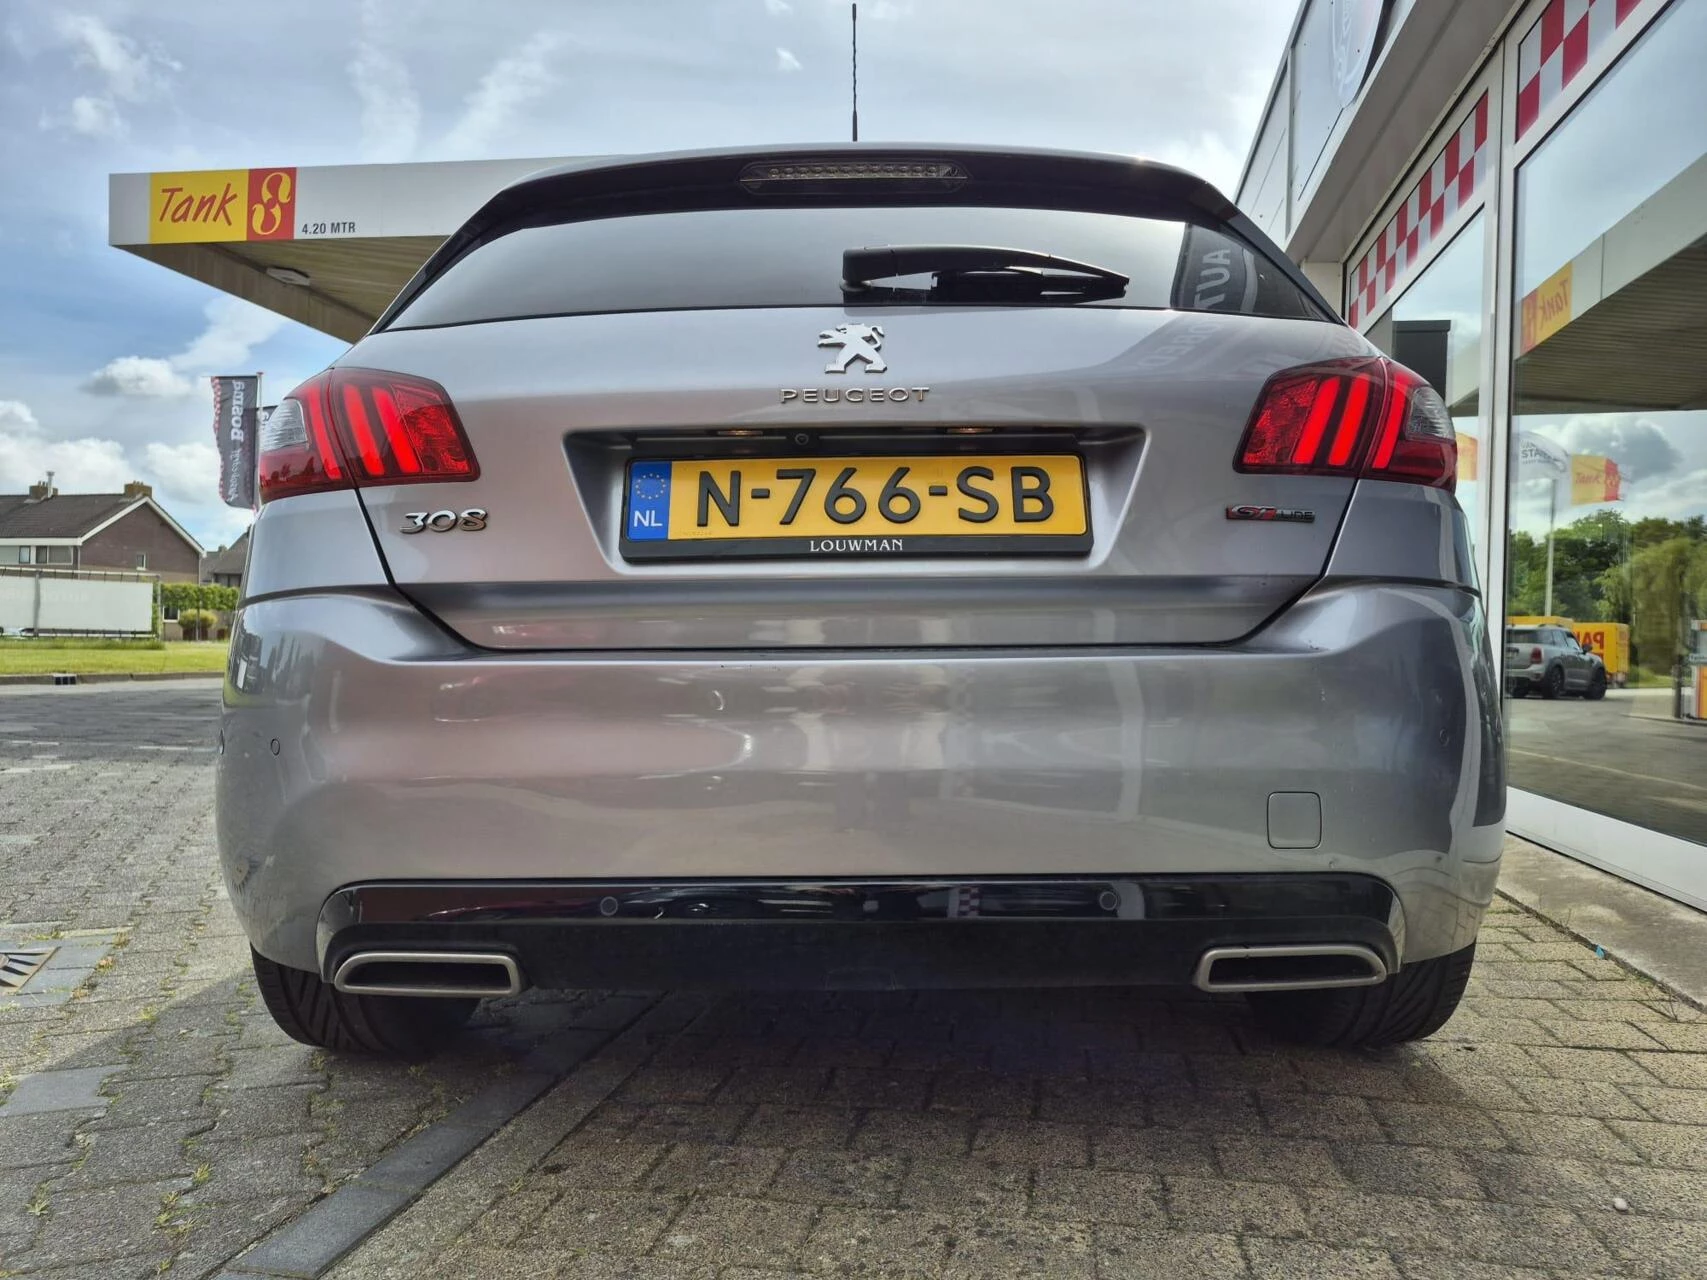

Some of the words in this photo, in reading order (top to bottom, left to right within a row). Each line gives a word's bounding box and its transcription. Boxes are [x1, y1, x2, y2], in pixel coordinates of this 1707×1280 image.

[159, 183, 237, 226] Tank
[302, 223, 327, 235] 4.20
[330, 221, 356, 234] MTR
[780, 387, 929, 403] PEUGEOT
[696, 465, 1055, 527] N-766-SB
[400, 508, 487, 534] 308
[633, 510, 662, 527] NL
[809, 538, 904, 553] LOUWMAN
